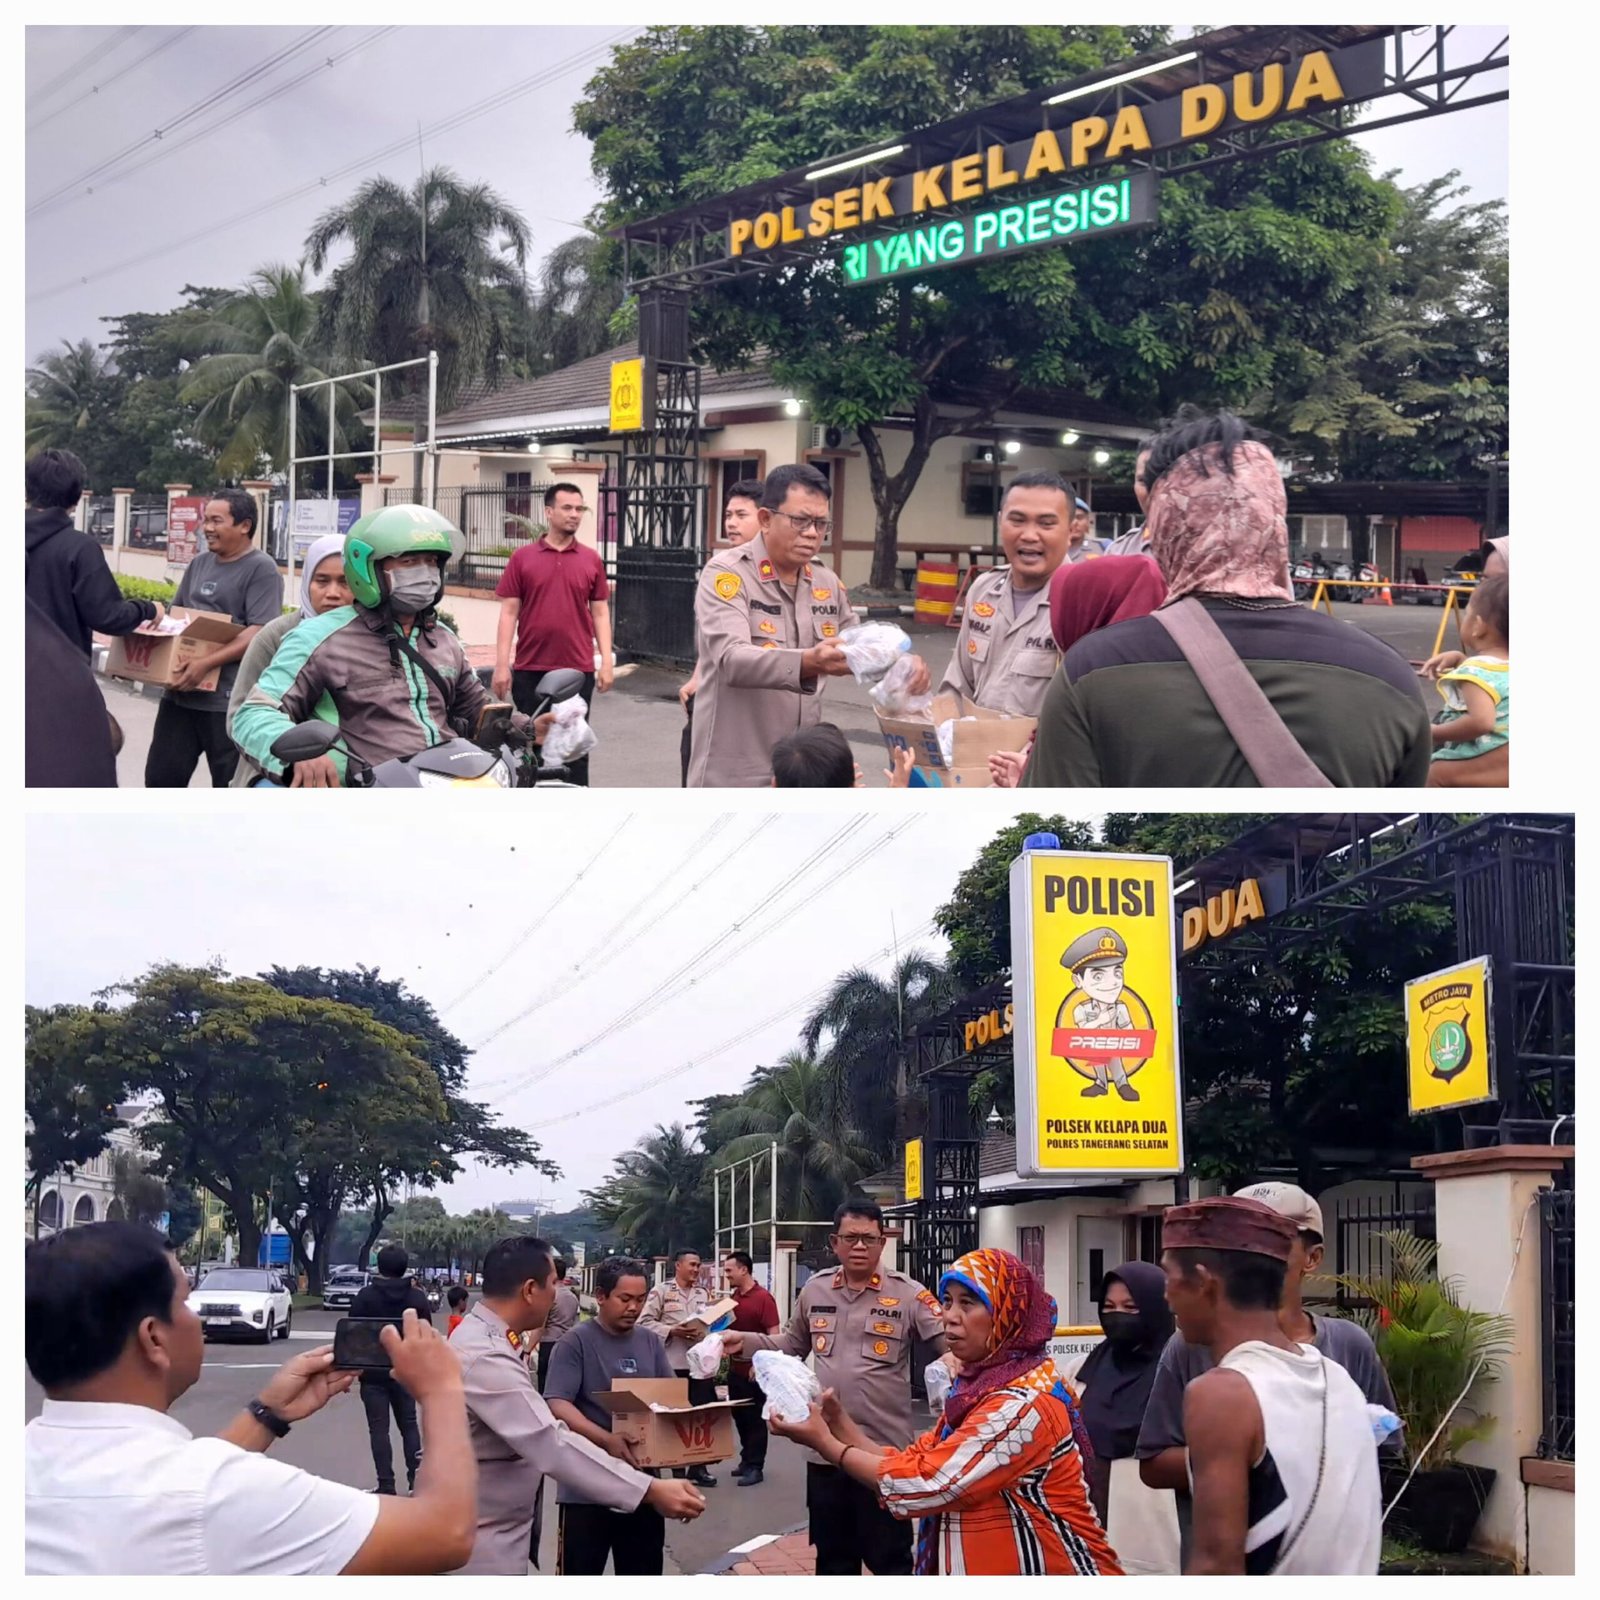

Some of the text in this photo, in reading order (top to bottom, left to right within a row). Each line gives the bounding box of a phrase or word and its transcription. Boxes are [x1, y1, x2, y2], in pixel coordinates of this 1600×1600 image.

[731, 50, 1344, 256] POLSEK KELAPA DUA
[873, 220, 965, 274] YANG
[974, 179, 1131, 254] PRESISI
[811, 605, 837, 615] POLRI
[1044, 874, 1155, 917] POLISI
[1183, 878, 1265, 951] DUA
[1423, 986, 1468, 1008] METRO JAYA
[1069, 1036, 1141, 1050] PRESISI
[1046, 1119, 1168, 1134] POLSEK KELAPA DUA
[1046, 1138, 1169, 1149] POLRES TANGERANG SELATAN
[870, 1308, 902, 1318] POLRI
[1053, 1344, 1079, 1354] POLSEK
[673, 1411, 720, 1448] Vit
